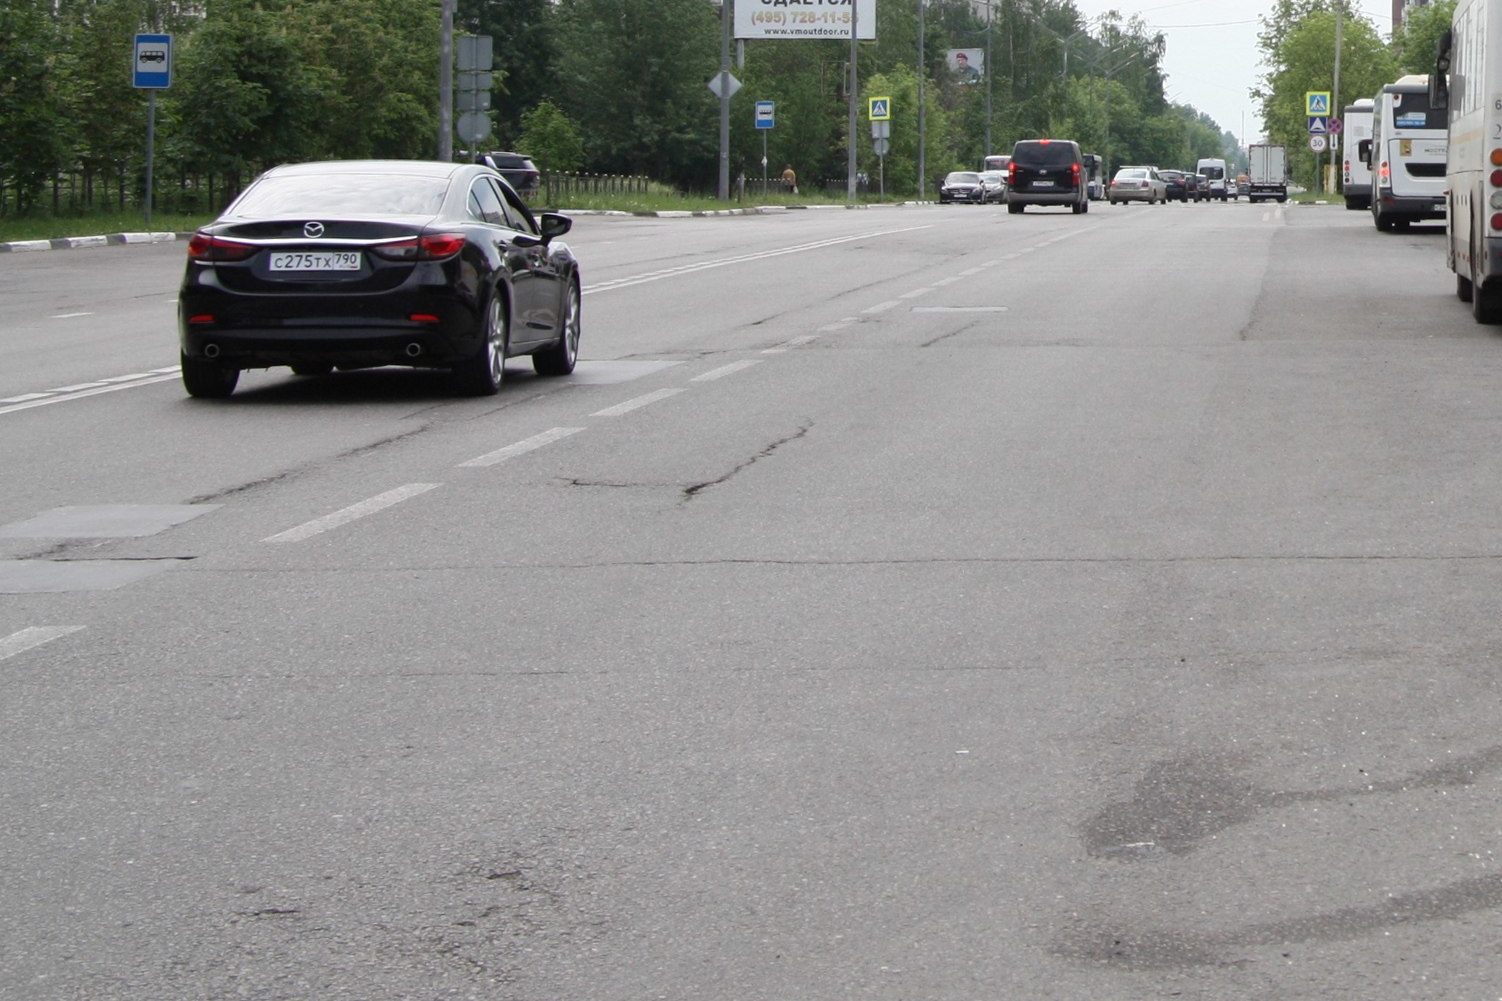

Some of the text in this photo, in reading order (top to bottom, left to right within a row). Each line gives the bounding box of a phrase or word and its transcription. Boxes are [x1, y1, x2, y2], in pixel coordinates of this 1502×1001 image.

[752, 11, 787, 26] (495)
[764, 28, 849, 36] www.vmoutdoor.ru
[1312, 139, 1323, 147] 30
[336, 253, 357, 264] 790
